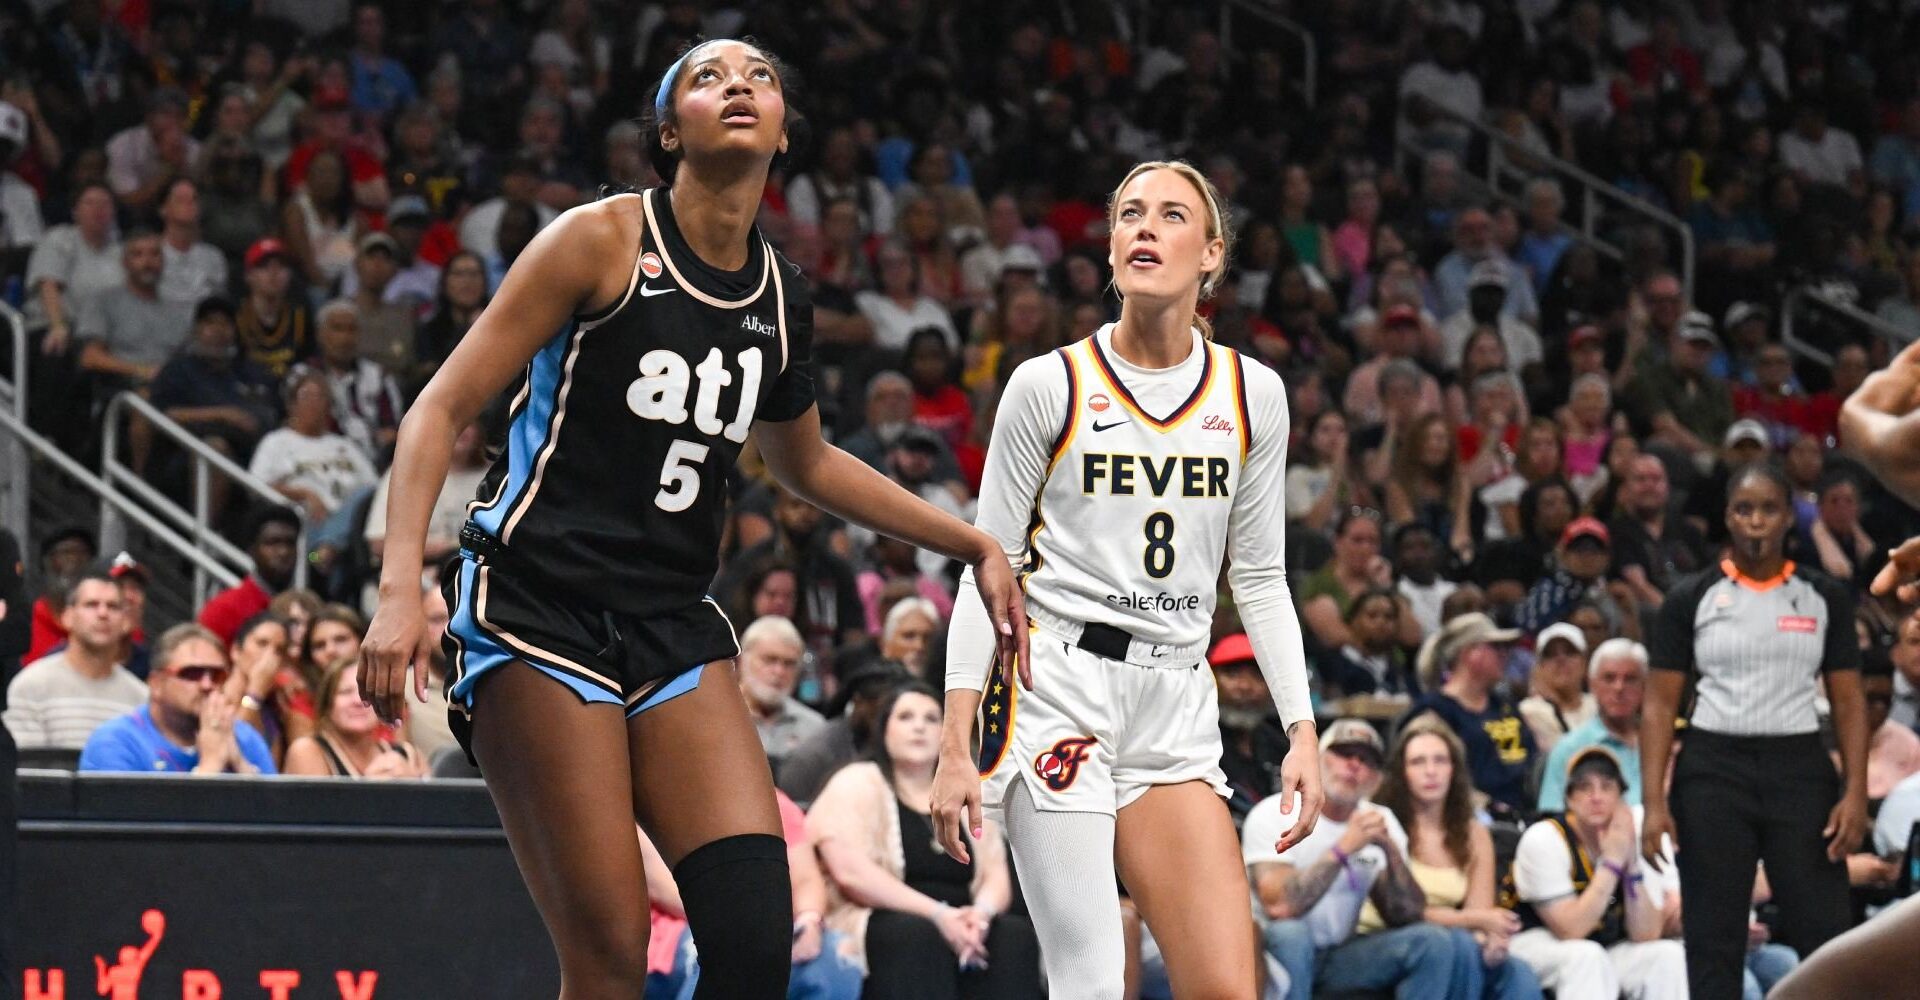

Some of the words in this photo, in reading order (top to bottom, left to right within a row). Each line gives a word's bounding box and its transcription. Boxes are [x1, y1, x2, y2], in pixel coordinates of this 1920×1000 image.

[741, 314, 776, 338] Albert
[626, 346, 763, 444] atl
[1201, 414, 1235, 437] Lilly
[654, 438, 710, 512] 5
[1082, 452, 1230, 498] FEVER
[1143, 510, 1176, 580] 8
[1106, 591, 1199, 615] salesforce
